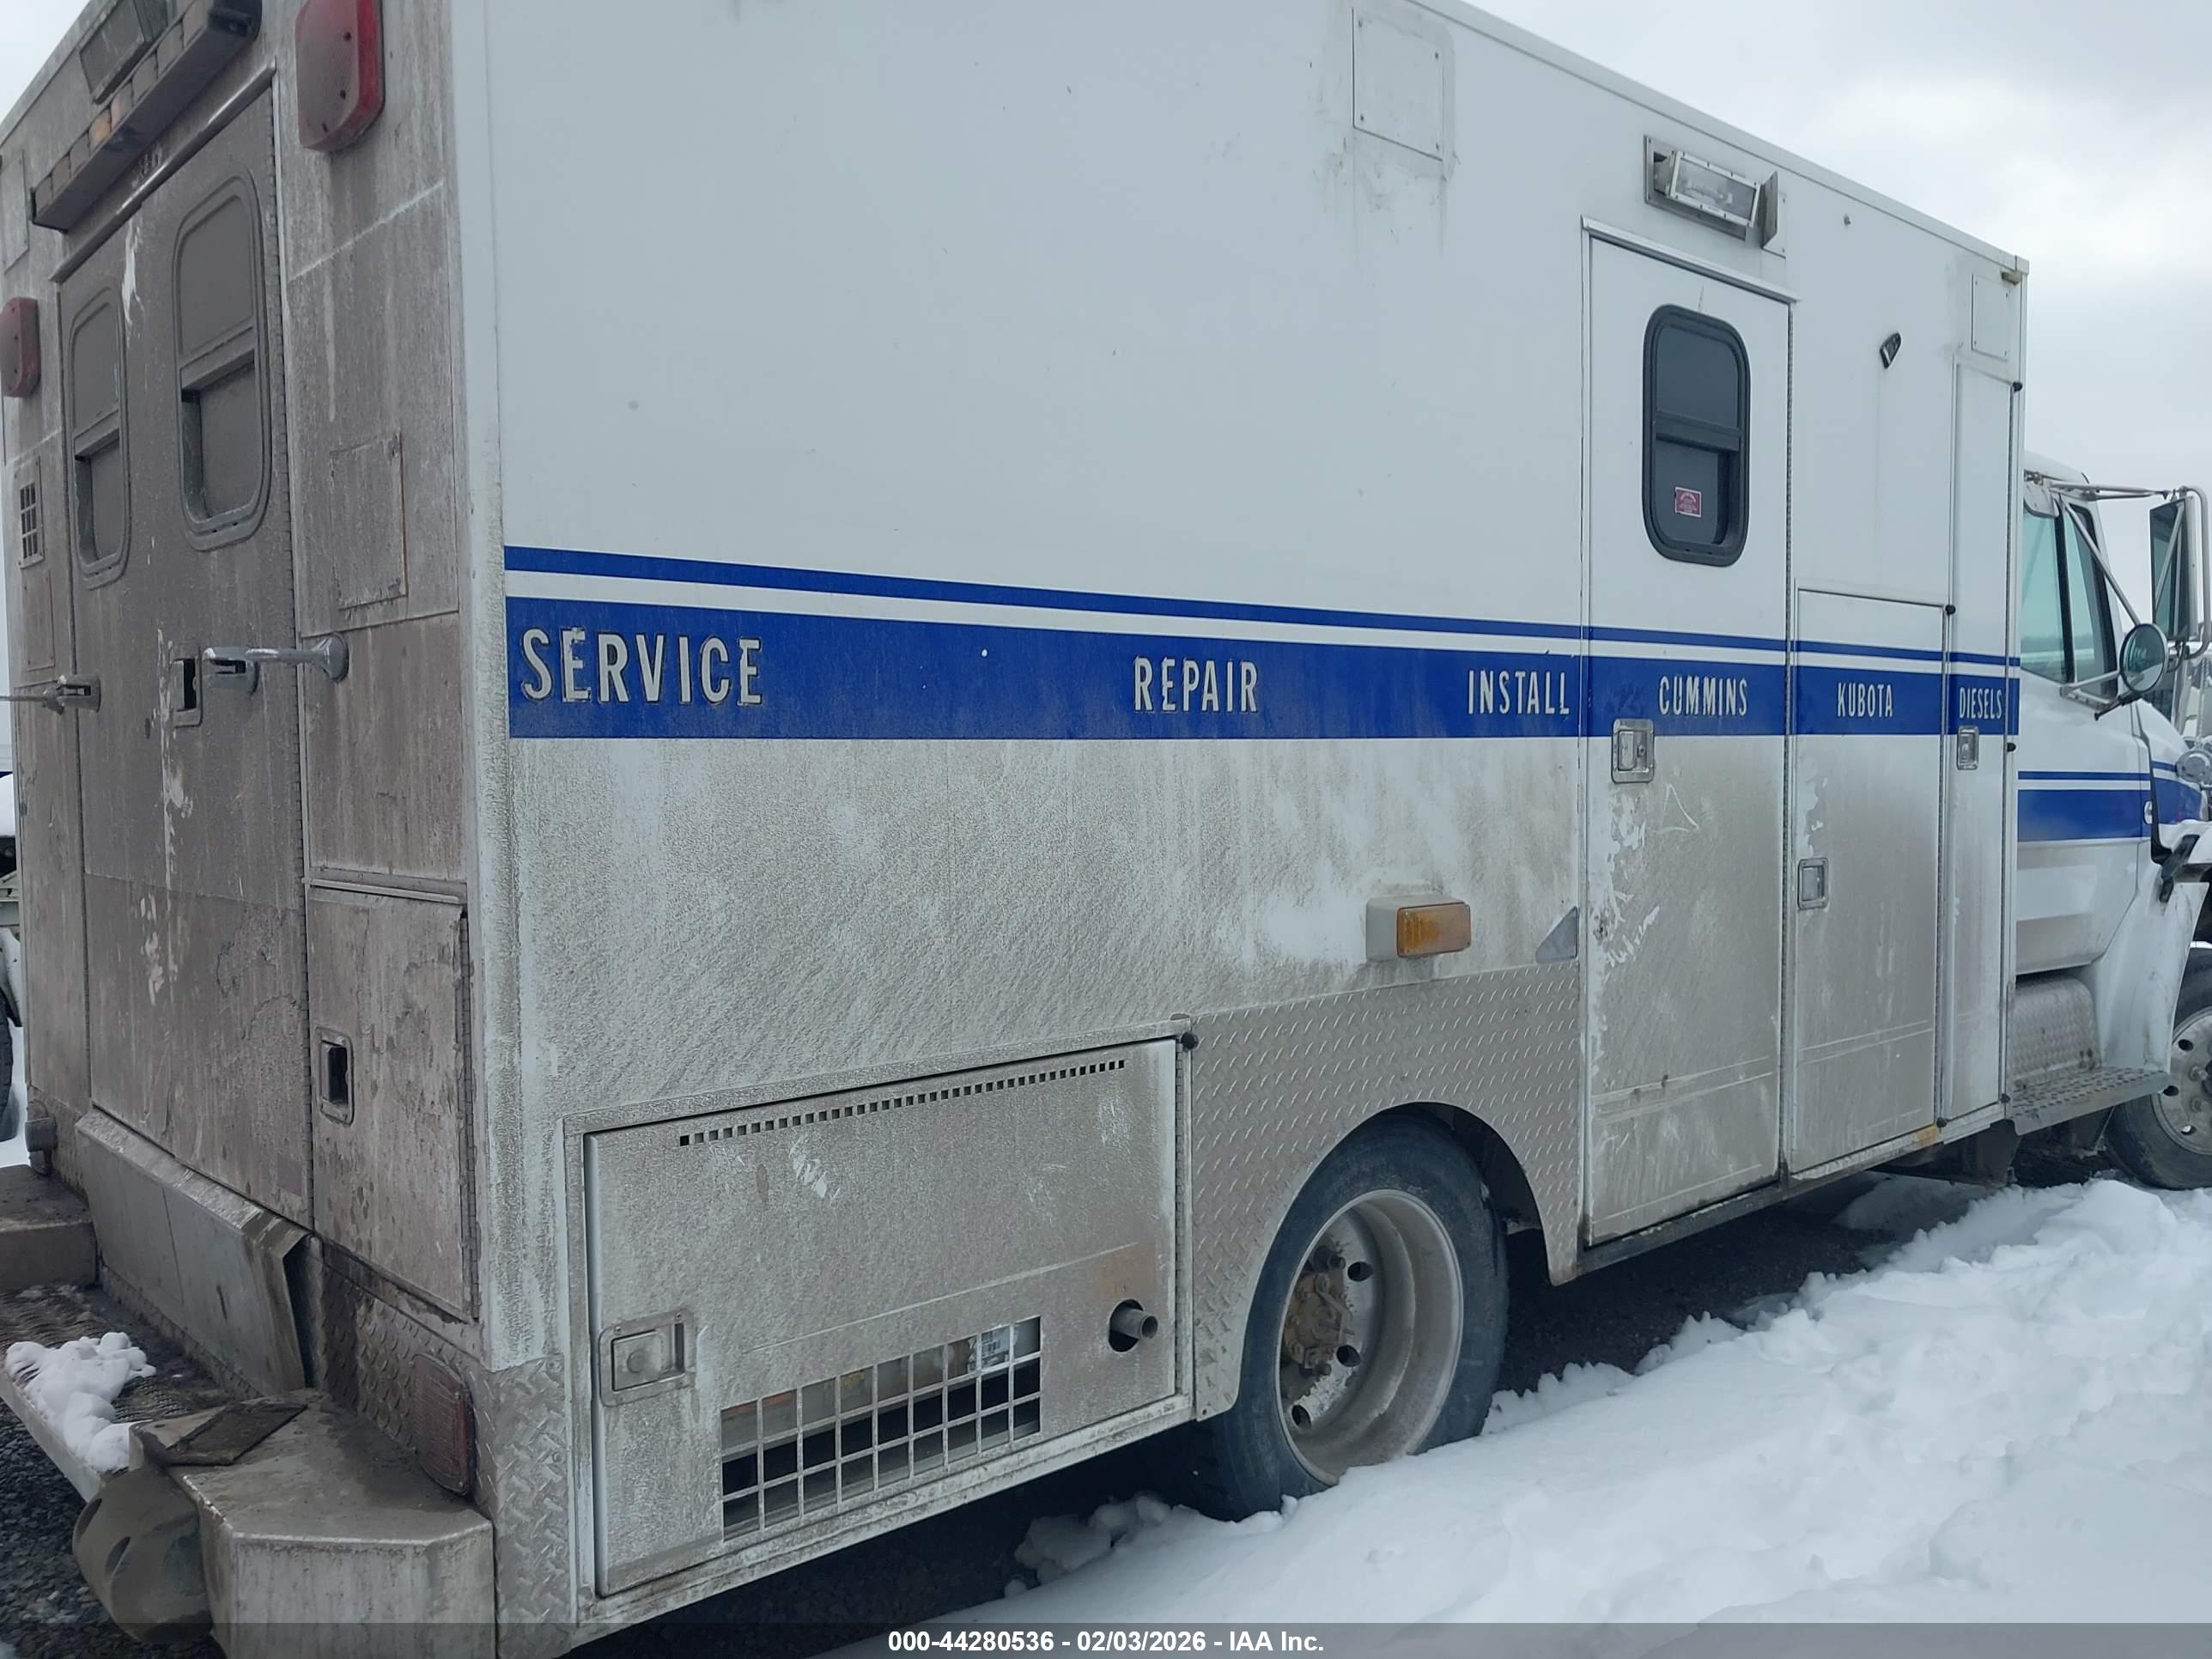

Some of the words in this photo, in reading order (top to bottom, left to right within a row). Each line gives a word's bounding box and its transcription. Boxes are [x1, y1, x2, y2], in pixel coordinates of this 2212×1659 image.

[521, 627, 763, 705] SERVICE
[1133, 655, 1258, 713] REPAIR
[1467, 669, 1570, 715] INSTALL
[1658, 675, 1748, 716] CUMMINS
[1837, 682, 1893, 718] KUBOTA
[1959, 686, 2002, 720] DIESELS
